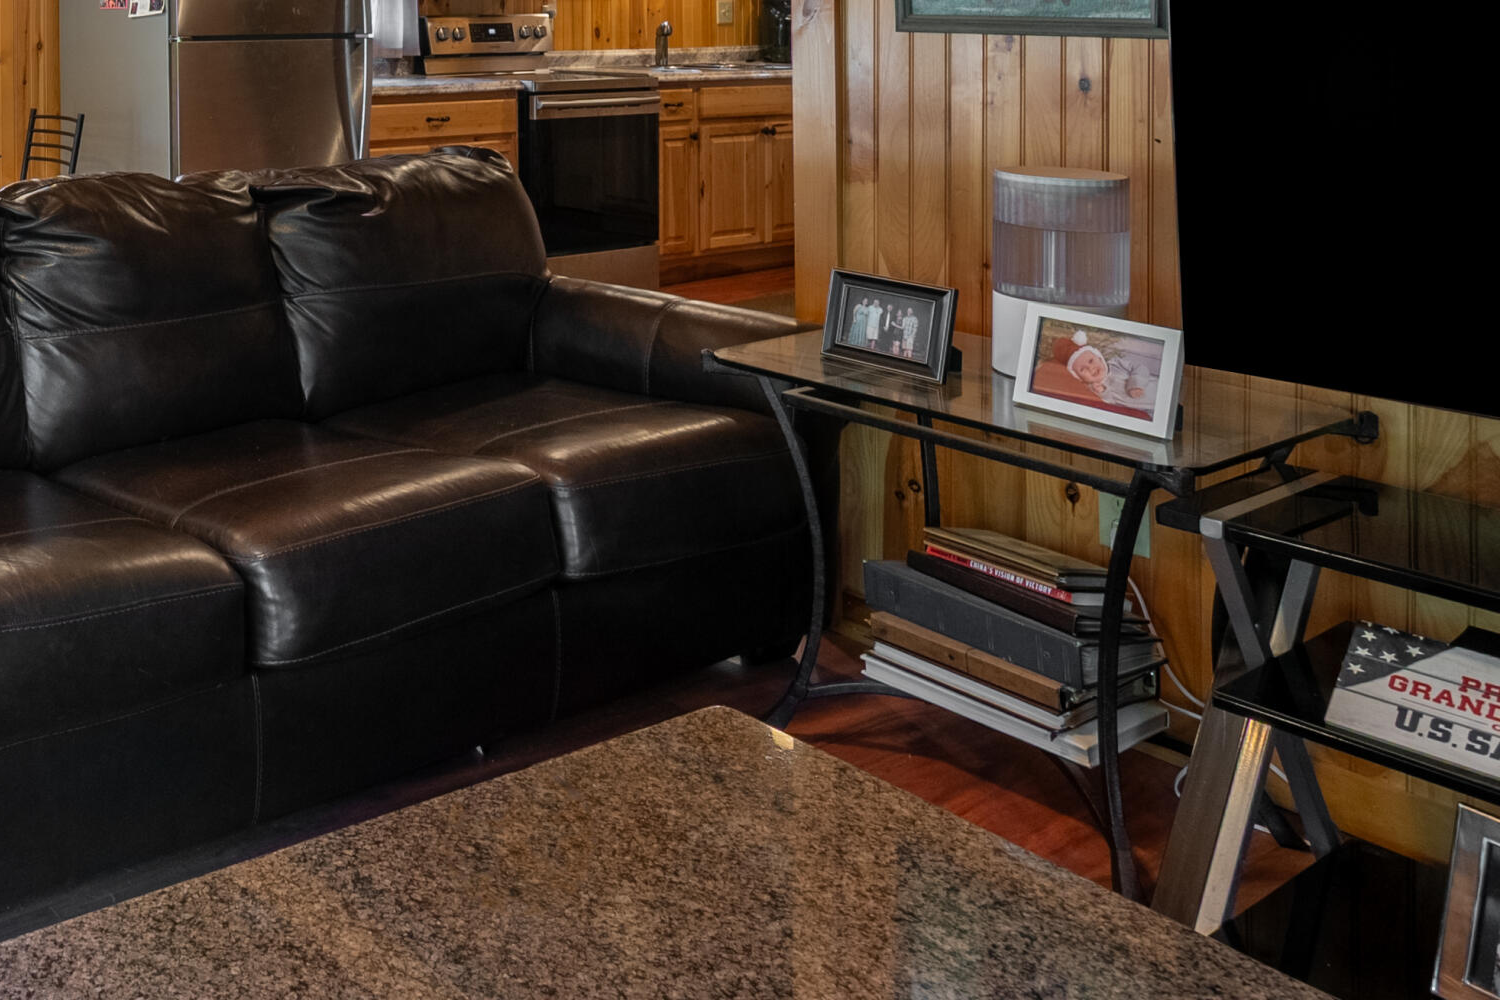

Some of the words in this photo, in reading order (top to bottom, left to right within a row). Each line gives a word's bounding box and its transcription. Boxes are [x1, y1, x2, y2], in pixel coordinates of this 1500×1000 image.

[994, 569, 1015, 583] VISION
[1015, 576, 1024, 585] OF
[1025, 578, 1052, 595] VICTORY
[1395, 705, 1457, 748] U.S.
